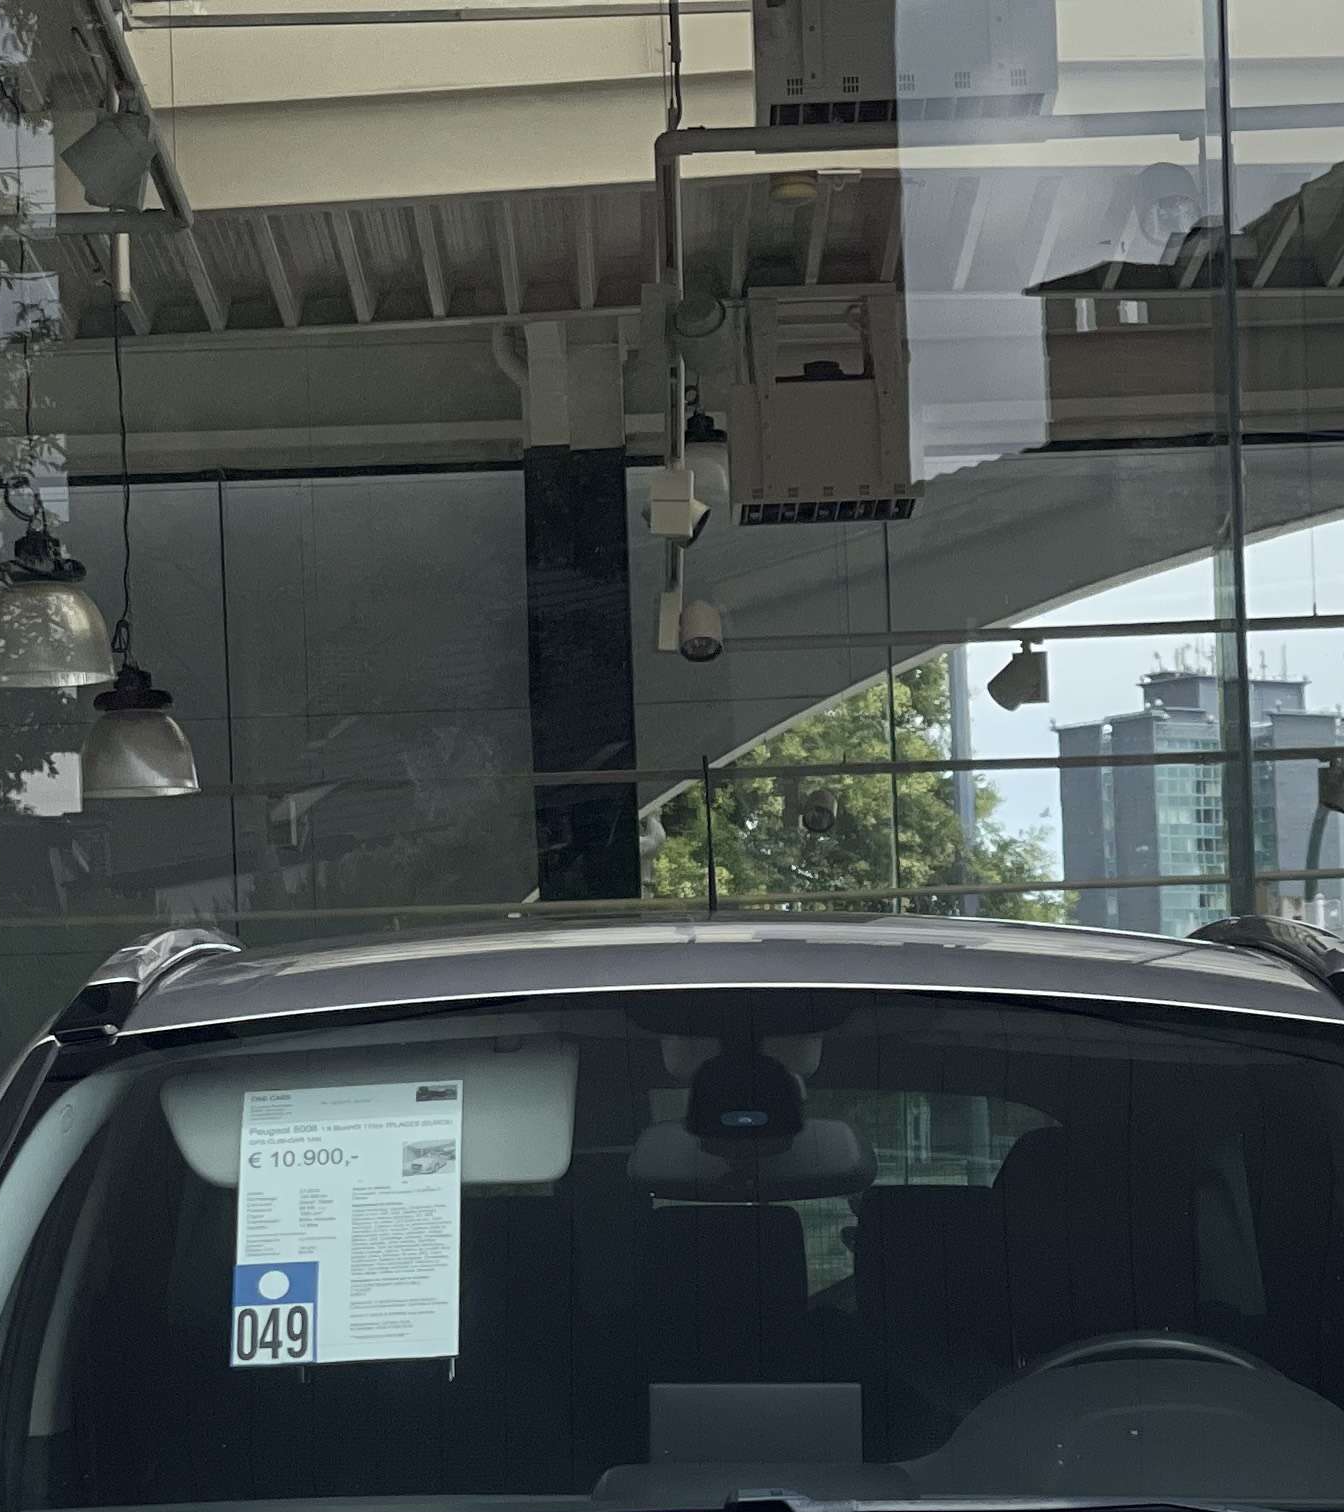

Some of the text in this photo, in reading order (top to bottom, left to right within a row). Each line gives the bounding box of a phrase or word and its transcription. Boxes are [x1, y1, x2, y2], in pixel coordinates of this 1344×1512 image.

[248, 1148, 359, 1169] € 10.900,-
[236, 1305, 309, 1361] 049
